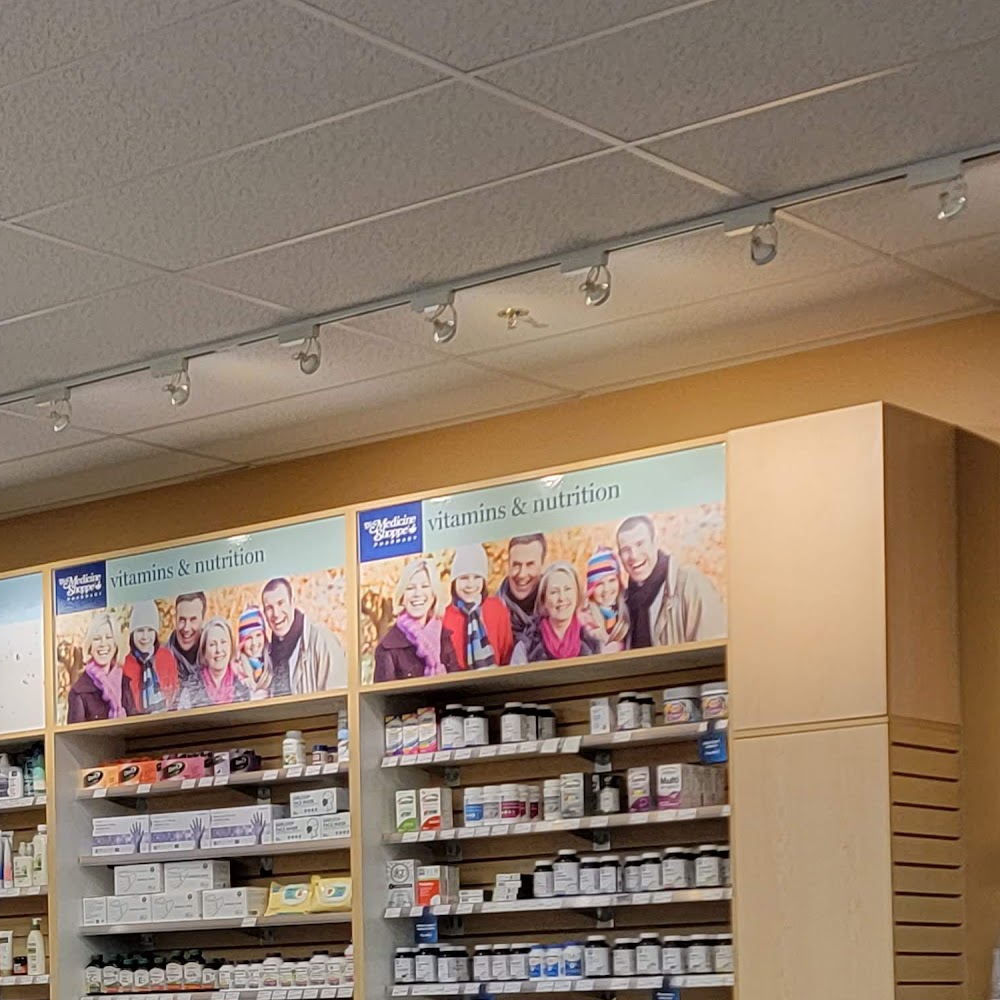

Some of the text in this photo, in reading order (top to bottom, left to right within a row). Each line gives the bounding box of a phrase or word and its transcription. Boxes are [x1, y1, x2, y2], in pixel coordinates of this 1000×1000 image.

[369, 516, 416, 534] Medicine
[427, 482, 620, 531] vitamins & nutrition
[110, 547, 264, 588] vitamins & nutrition
